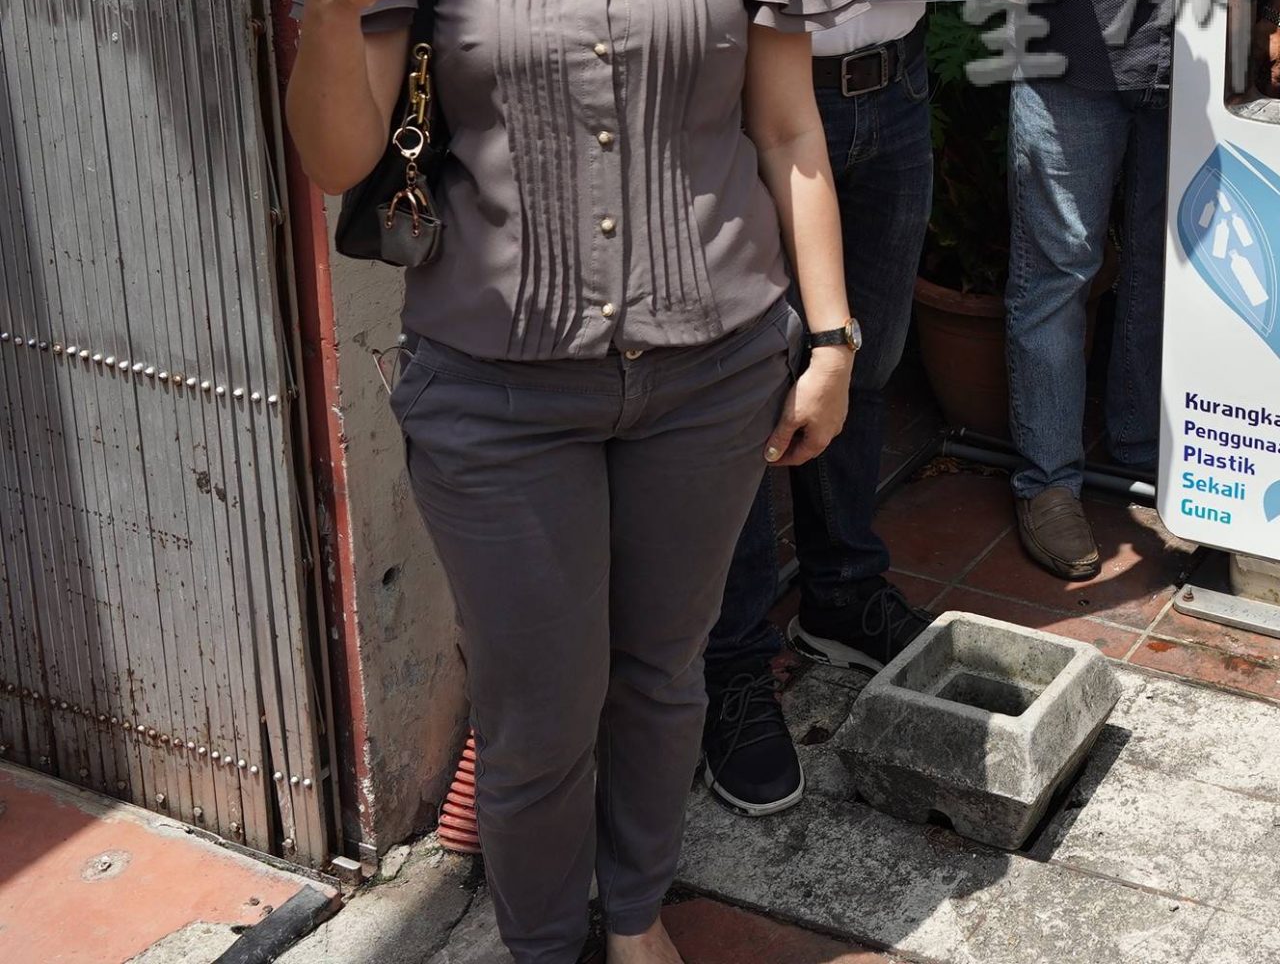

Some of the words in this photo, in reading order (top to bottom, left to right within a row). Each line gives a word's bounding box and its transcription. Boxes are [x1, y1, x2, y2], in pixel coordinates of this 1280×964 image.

[1183, 444, 1256, 476] Plastik
[1182, 471, 1246, 501] Sekali
[1181, 498, 1232, 525] Guna
